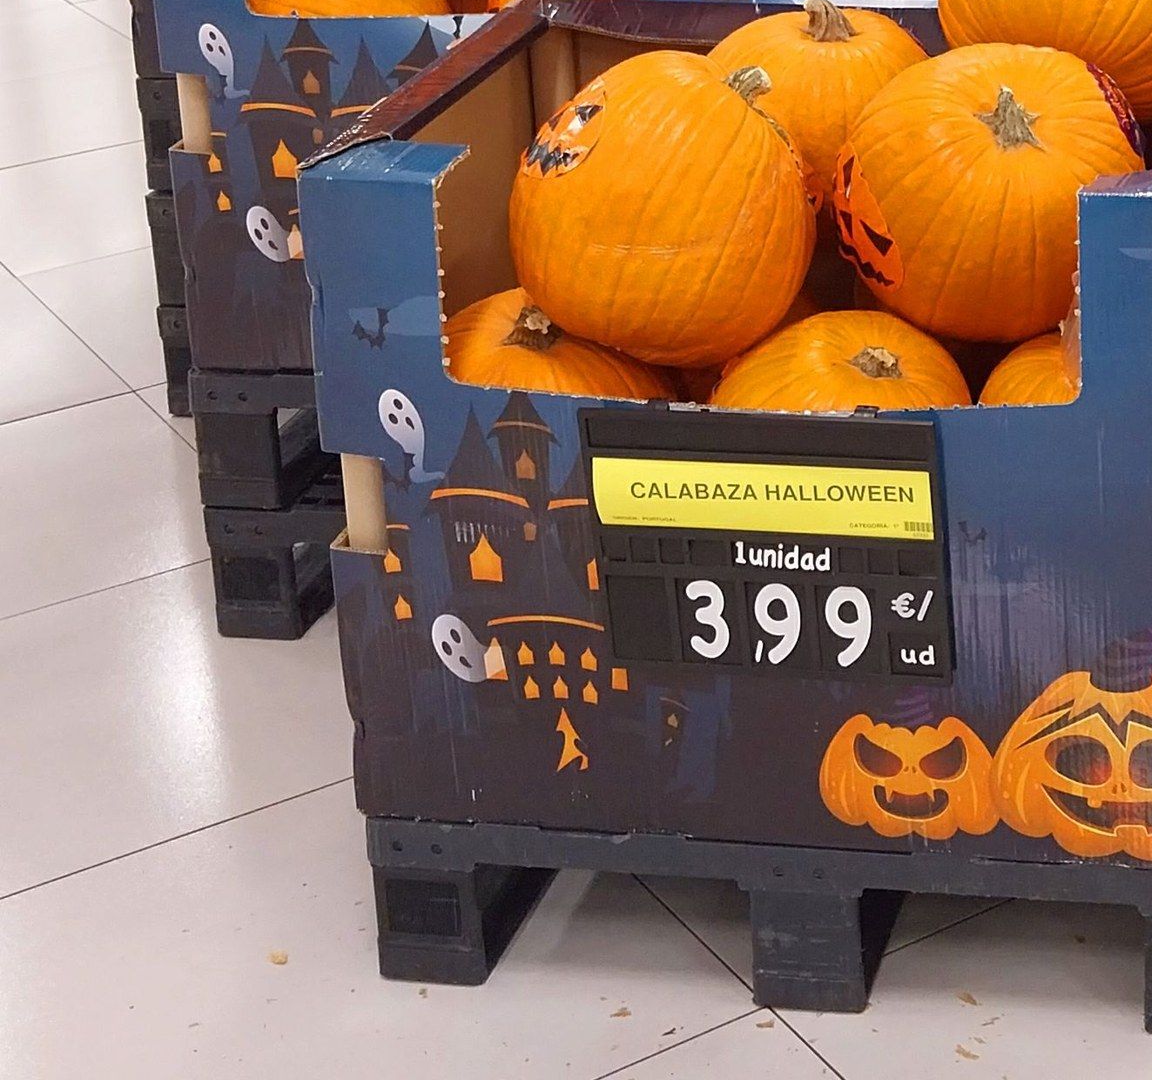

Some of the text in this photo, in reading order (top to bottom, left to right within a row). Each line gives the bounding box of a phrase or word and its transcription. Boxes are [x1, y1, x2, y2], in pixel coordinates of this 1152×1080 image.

[630, 481, 914, 503] CALABAZA HALLOWEEN
[685, 579, 873, 668] 3,99
[900, 645, 936, 666] ud
